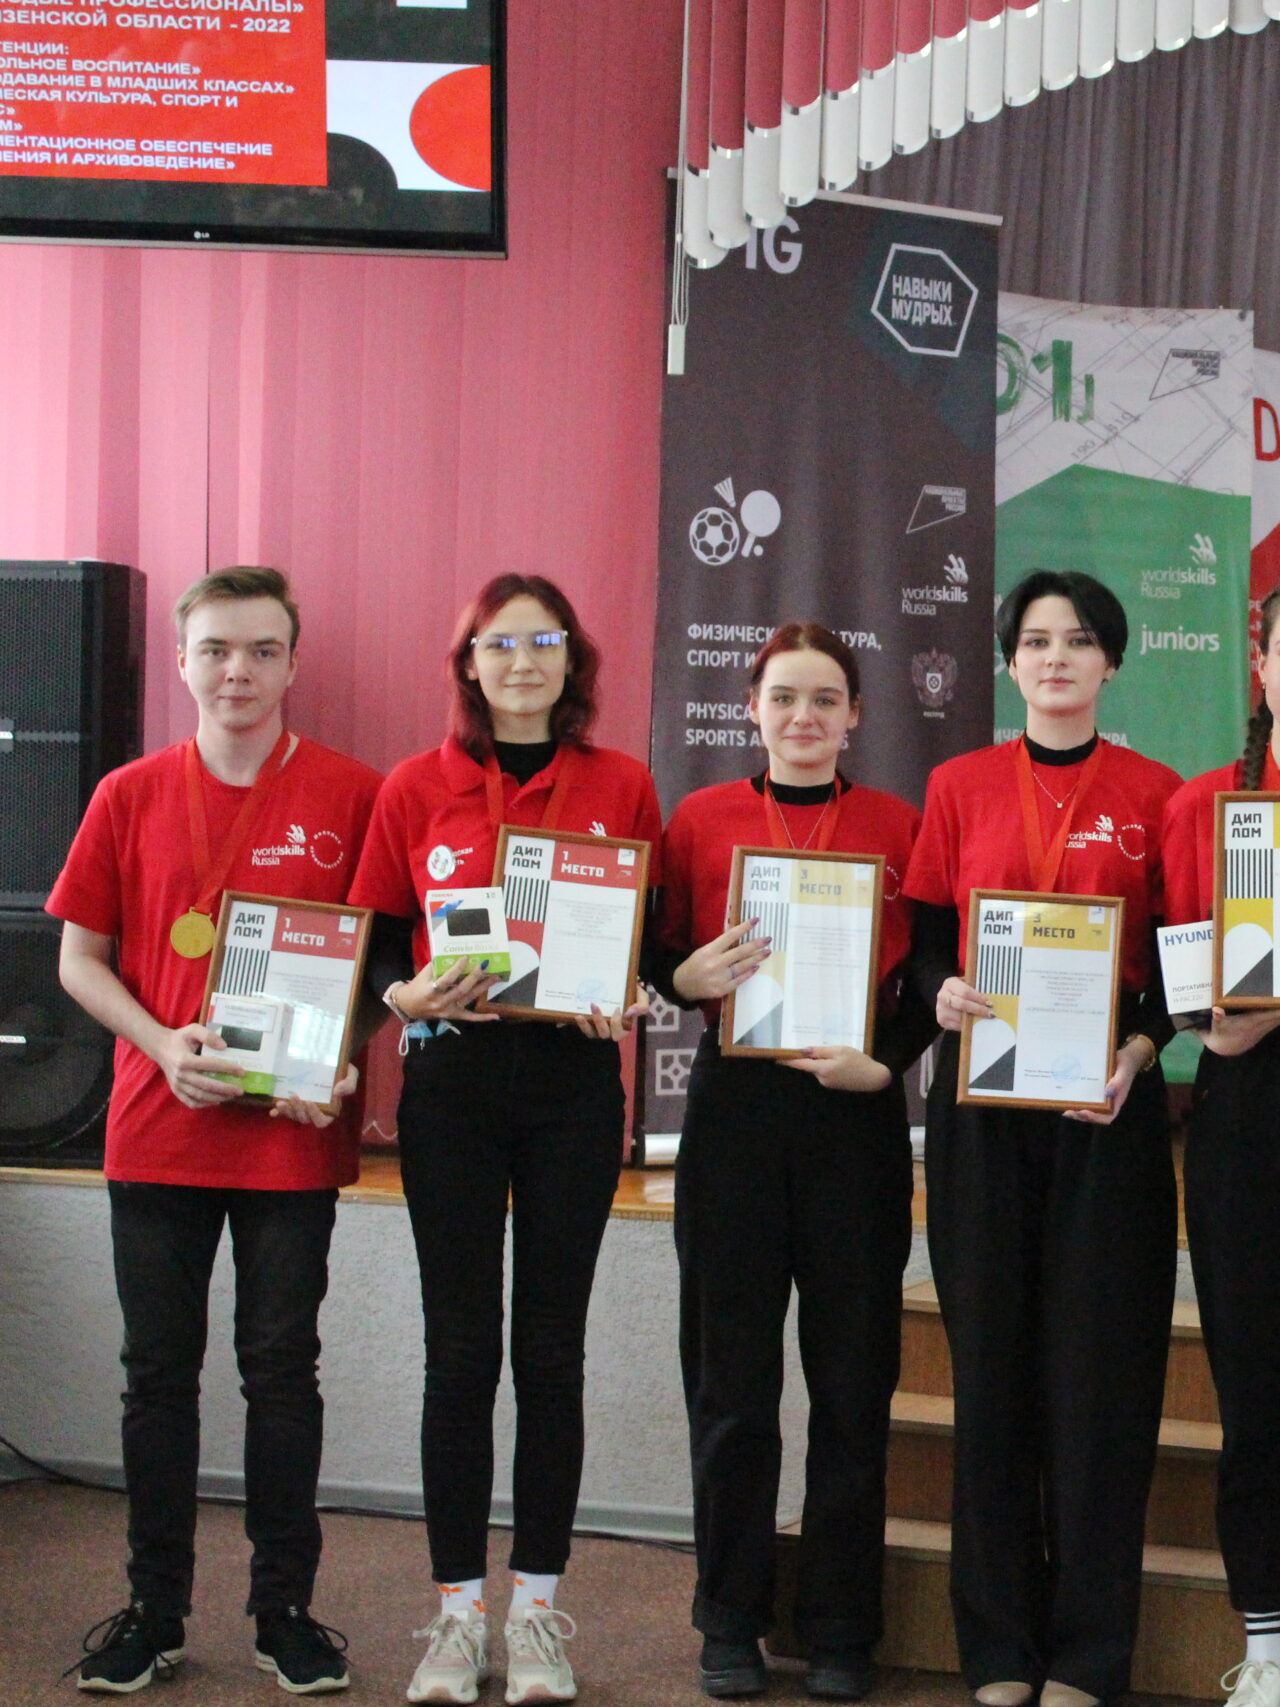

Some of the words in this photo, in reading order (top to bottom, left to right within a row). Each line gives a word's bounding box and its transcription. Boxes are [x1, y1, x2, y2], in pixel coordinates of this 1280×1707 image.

[0, 9, 108, 27] ЗЕНСКОЙ
[116, 13, 221, 30] ОБЛАСТИ
[242, 17, 291, 33] 2022
[0, 41, 70, 55] ЕНЦИИ:
[72, 59, 201, 75] ВОСПИТАНИЕ»
[0, 72, 86, 88] ДАВАНИЕ
[90, 75, 102, 88] В
[107, 76, 199, 91] МЛАДШИХ
[203, 79, 295, 94] КЛАССАХ»
[0, 88, 62, 101] ЕСКАЯ
[66, 90, 157, 107] КУЛЬТУРА,
[162, 93, 222, 107] СПОРТ
[225, 95, 238, 108] И
[0, 134, 136, 151] ЕНТАЦИОННОЕ
[139, 139, 273, 156] ОБЕСПЕЧЕНИЕ
[0, 150, 52, 164] ЕНИЯ
[55, 152, 68, 165] И
[72, 152, 236, 170] АРХИВОВЕДЕНИЕ»
[892, 274, 953, 303] НАВЫКИ
[891, 298, 954, 327] МУДРЫХ
[1141, 567, 1217, 585] worldskills
[902, 584, 968, 602] worldskills
[1141, 583, 1181, 599] Russia
[901, 599, 937, 615] Russia
[687, 622, 776, 643] ФИЗИЧЕСК
[1140, 624, 1221, 655] juniors
[686, 649, 742, 668] СПОРТ
[686, 702, 752, 721] PHYSICA
[685, 728, 747, 748] SPORTS
[1231, 813, 1262, 827] ДИП
[1068, 831, 1113, 843] orldskills
[1231, 827, 1262, 838] ЛОМ
[252, 844, 306, 856] worldskills
[512, 845, 543, 858] ДИП
[563, 851, 569, 861] 1
[252, 855, 281, 866] Russia
[511, 857, 541, 869] ЛОМ
[561, 863, 605, 878] МЕСТО
[750, 866, 781, 879] ДИП
[801, 869, 808, 880] 3
[750, 880, 780, 892] ЛОМ
[800, 883, 842, 896] МЕСТО
[234, 911, 266, 926] ДИП
[284, 917, 291, 929] 1
[984, 910, 1014, 923] ДИП
[1032, 912, 1042, 923] 3
[233, 925, 262, 939] ЛОМ
[983, 924, 1013, 936] ЛОМ
[1032, 926, 1076, 939] МЕСТО
[282, 931, 326, 947] МЕСТО
